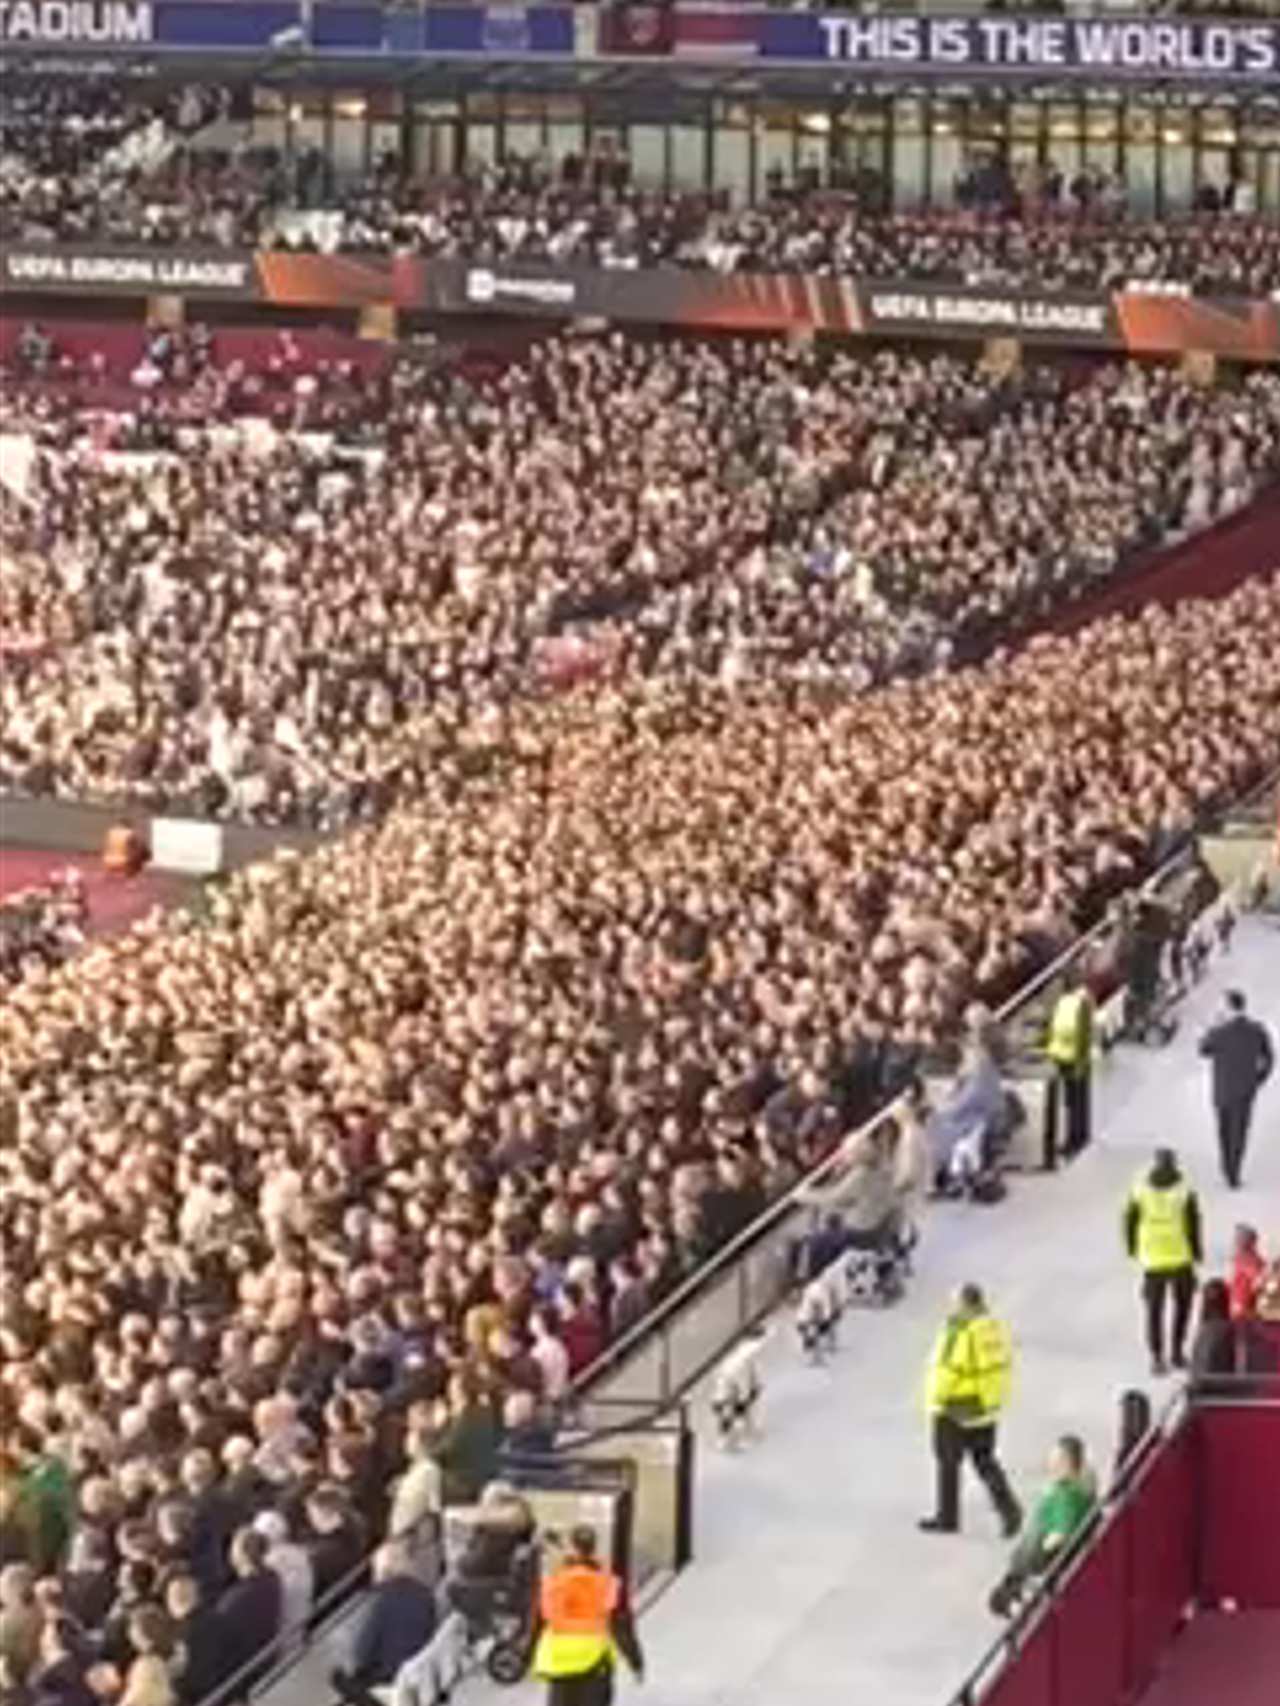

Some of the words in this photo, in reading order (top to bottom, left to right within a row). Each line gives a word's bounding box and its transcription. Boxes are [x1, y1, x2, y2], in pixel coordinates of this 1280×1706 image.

[819, 16, 920, 60] THIS
[930, 18, 970, 62] IS
[978, 19, 1065, 63] THE
[1074, 21, 1274, 70] WORLD'S
